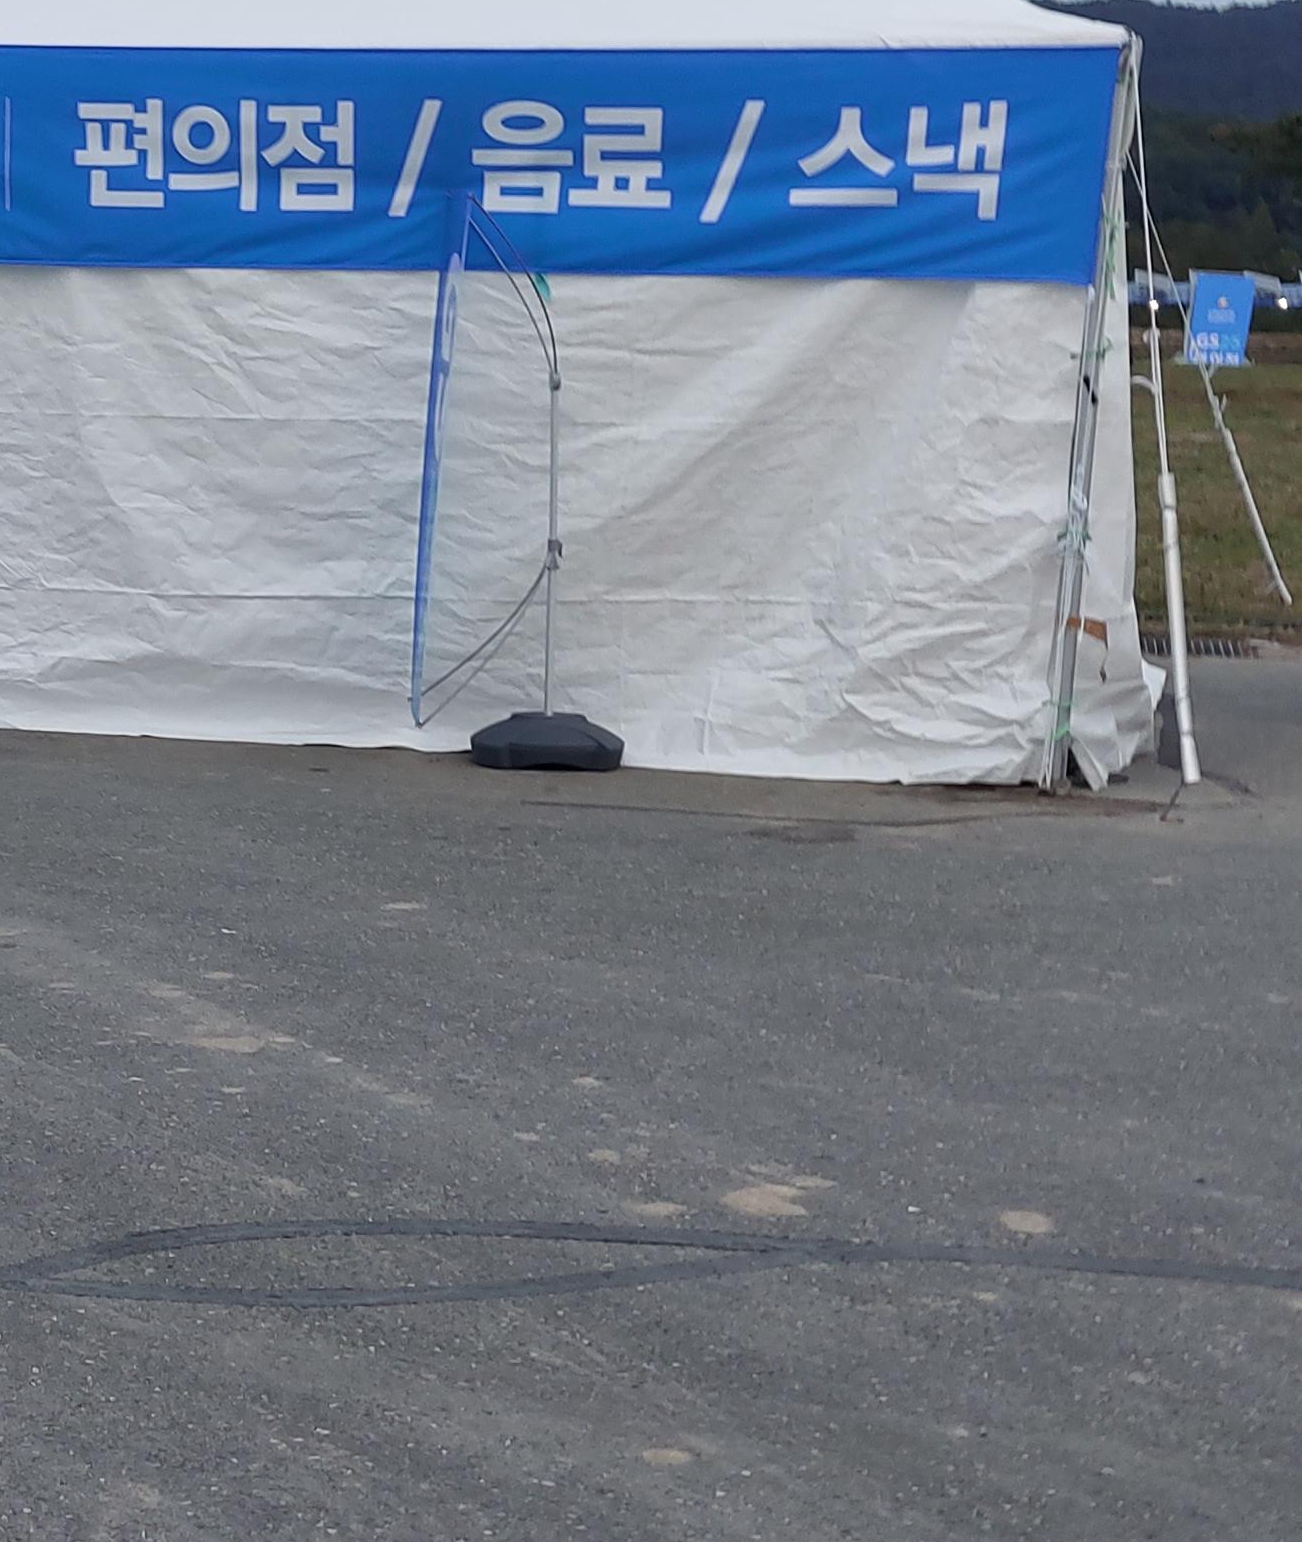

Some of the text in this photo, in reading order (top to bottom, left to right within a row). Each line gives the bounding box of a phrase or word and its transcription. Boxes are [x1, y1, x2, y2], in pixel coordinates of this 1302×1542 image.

[75, 99, 1009, 223] 편의점 / 음료 / 스낵
